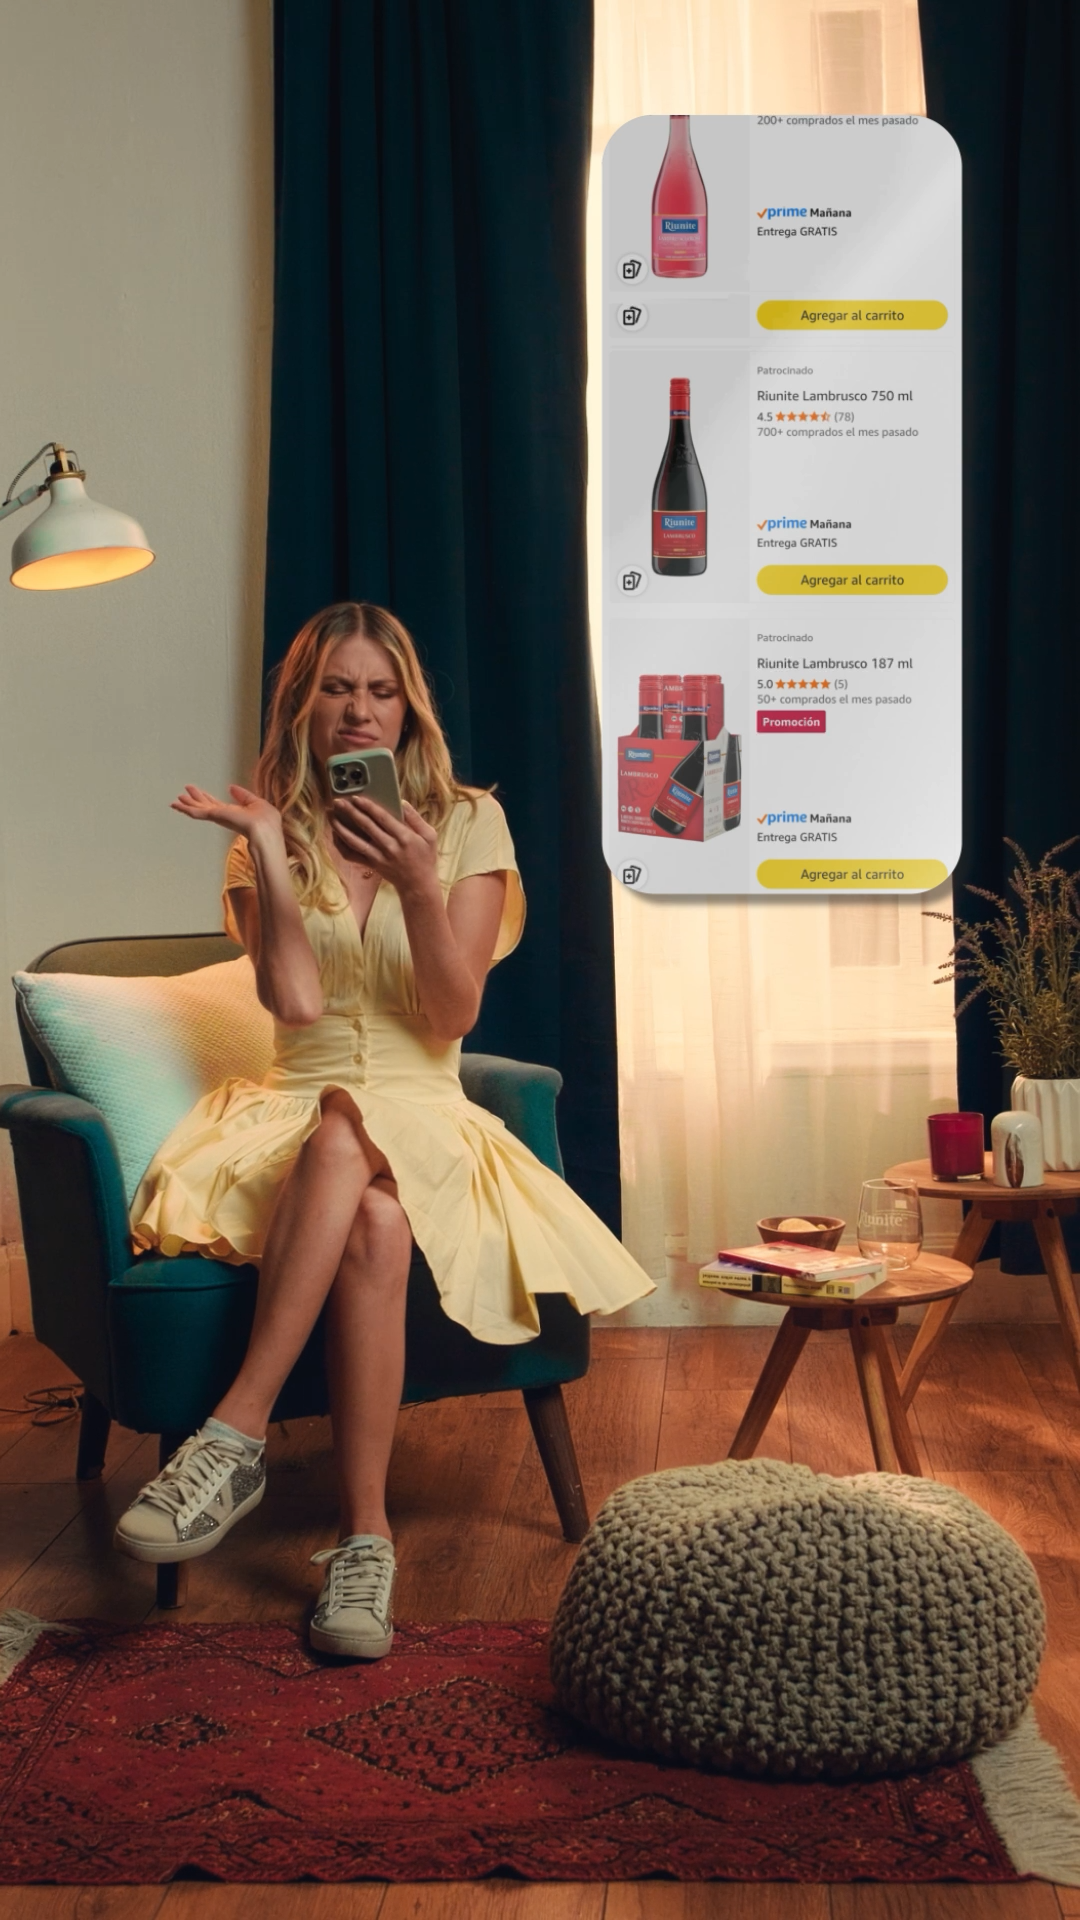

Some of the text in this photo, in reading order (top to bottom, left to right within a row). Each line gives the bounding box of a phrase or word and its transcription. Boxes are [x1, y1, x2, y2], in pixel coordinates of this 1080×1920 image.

[665, 221, 697, 232] Riunite
[664, 517, 695, 528] Riunite
[620, 770, 659, 779] LAMBRUSCO
